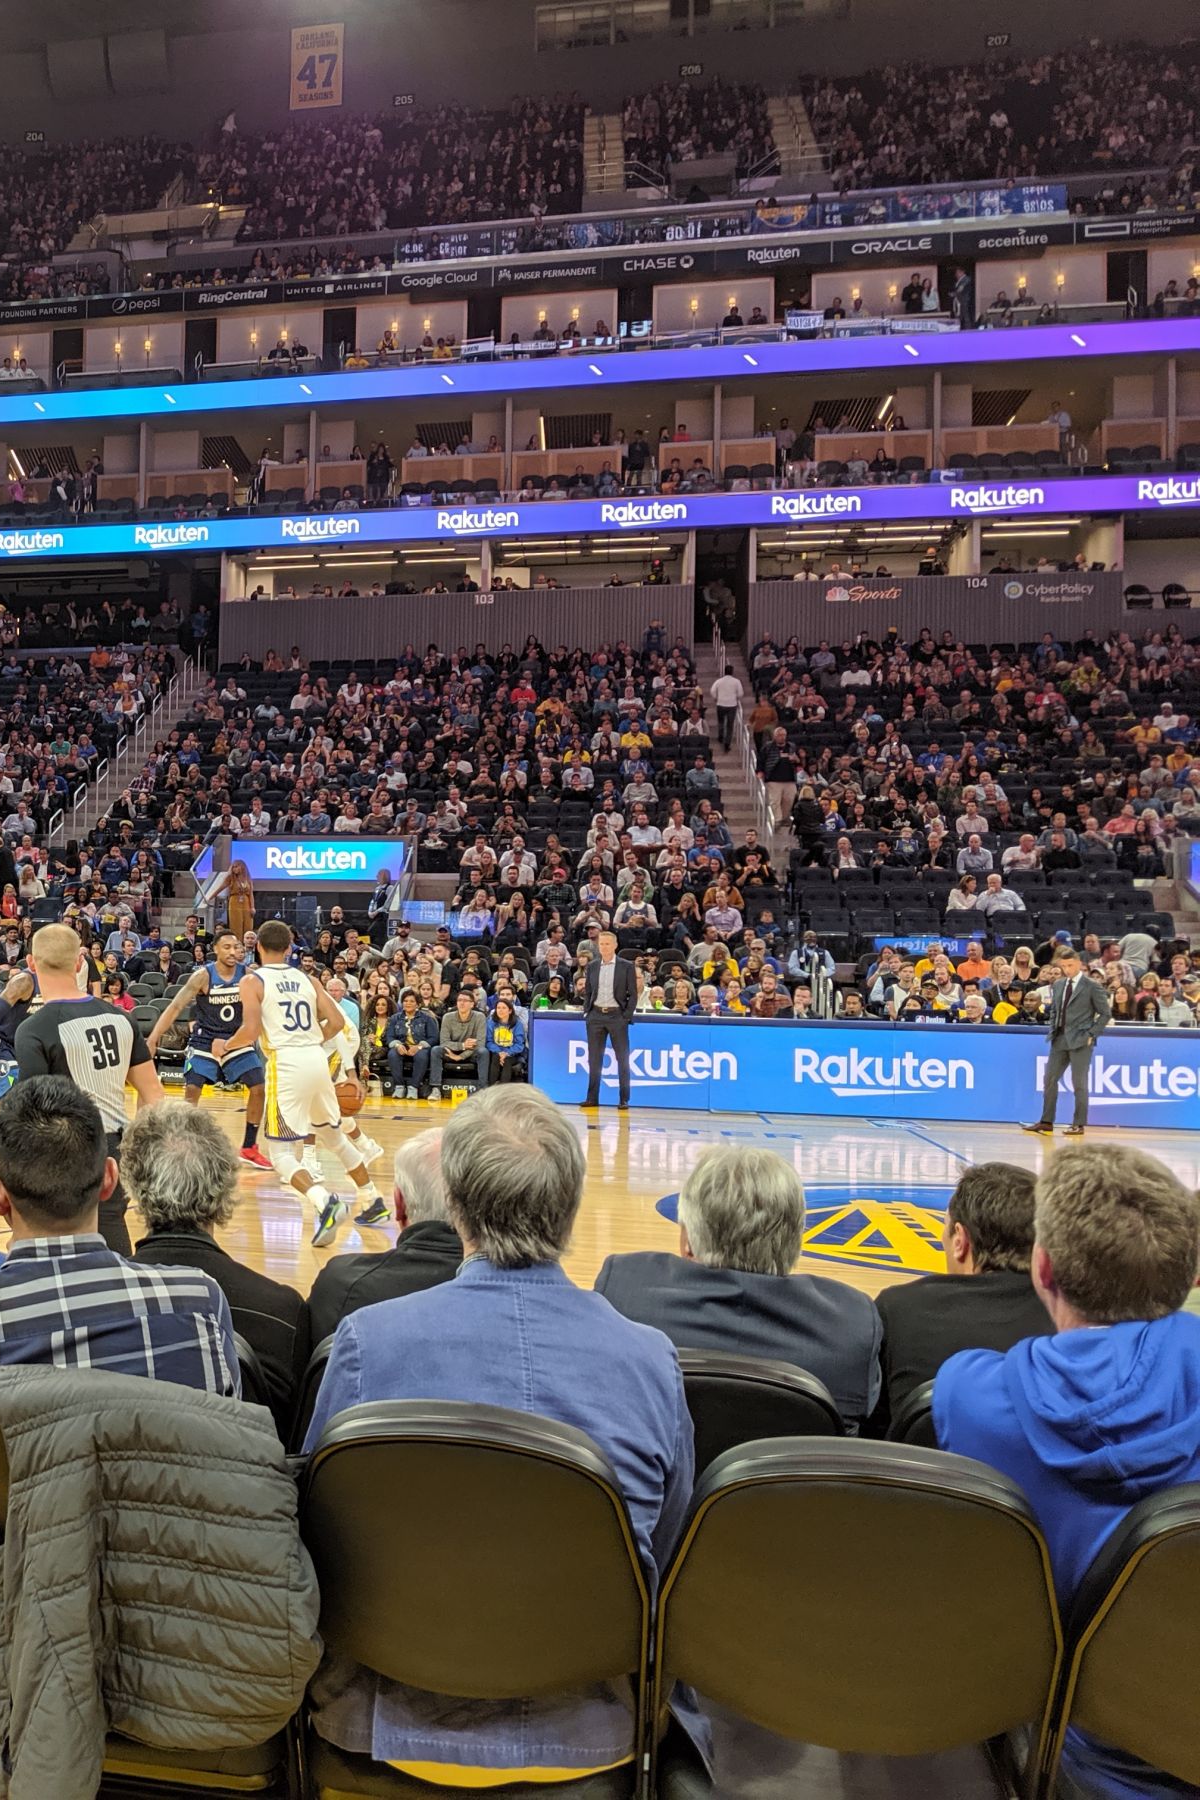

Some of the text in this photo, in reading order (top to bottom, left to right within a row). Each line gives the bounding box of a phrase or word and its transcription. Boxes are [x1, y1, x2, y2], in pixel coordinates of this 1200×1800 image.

[987, 35, 1008, 46] 207
[296, 54, 338, 89] 47
[298, 91, 334, 102] SEASONS
[394, 95, 414, 105] 205
[26, 132, 43, 141] 204
[851, 238, 932, 255] ORACLE
[978, 233, 1048, 249] accenture
[747, 248, 800, 262] Rakuten
[514, 266, 597, 280] KAISER PERMANENTE
[623, 258, 676, 272] CHASE
[286, 281, 383, 295] UNITED AIRLINES
[401, 271, 478, 290] Google Cloud
[129, 297, 161, 312] pepsi
[198, 289, 267, 304] RingCentral
[0, 306, 78, 318] FOUNDING PARTNERS
[770, 494, 862, 515] Rakuten
[951, 487, 1044, 508] Rakuten
[437, 510, 519, 529] Rakuten
[601, 501, 687, 523] Rakuten
[135, 525, 209, 544] Rakuten
[281, 517, 360, 536] Rakuten
[966, 577, 988, 588] 104
[1026, 583, 1094, 596] CyberPolicy
[474, 594, 495, 604] 103
[849, 586, 902, 602] Sports
[266, 847, 366, 869] Rakuten
[208, 995, 241, 1005] MINNESO
[220, 1004, 235, 1022] 0
[278, 1000, 312, 1031] 30
[85, 1024, 121, 1070] 39
[794, 1047, 974, 1089] Rakuten
